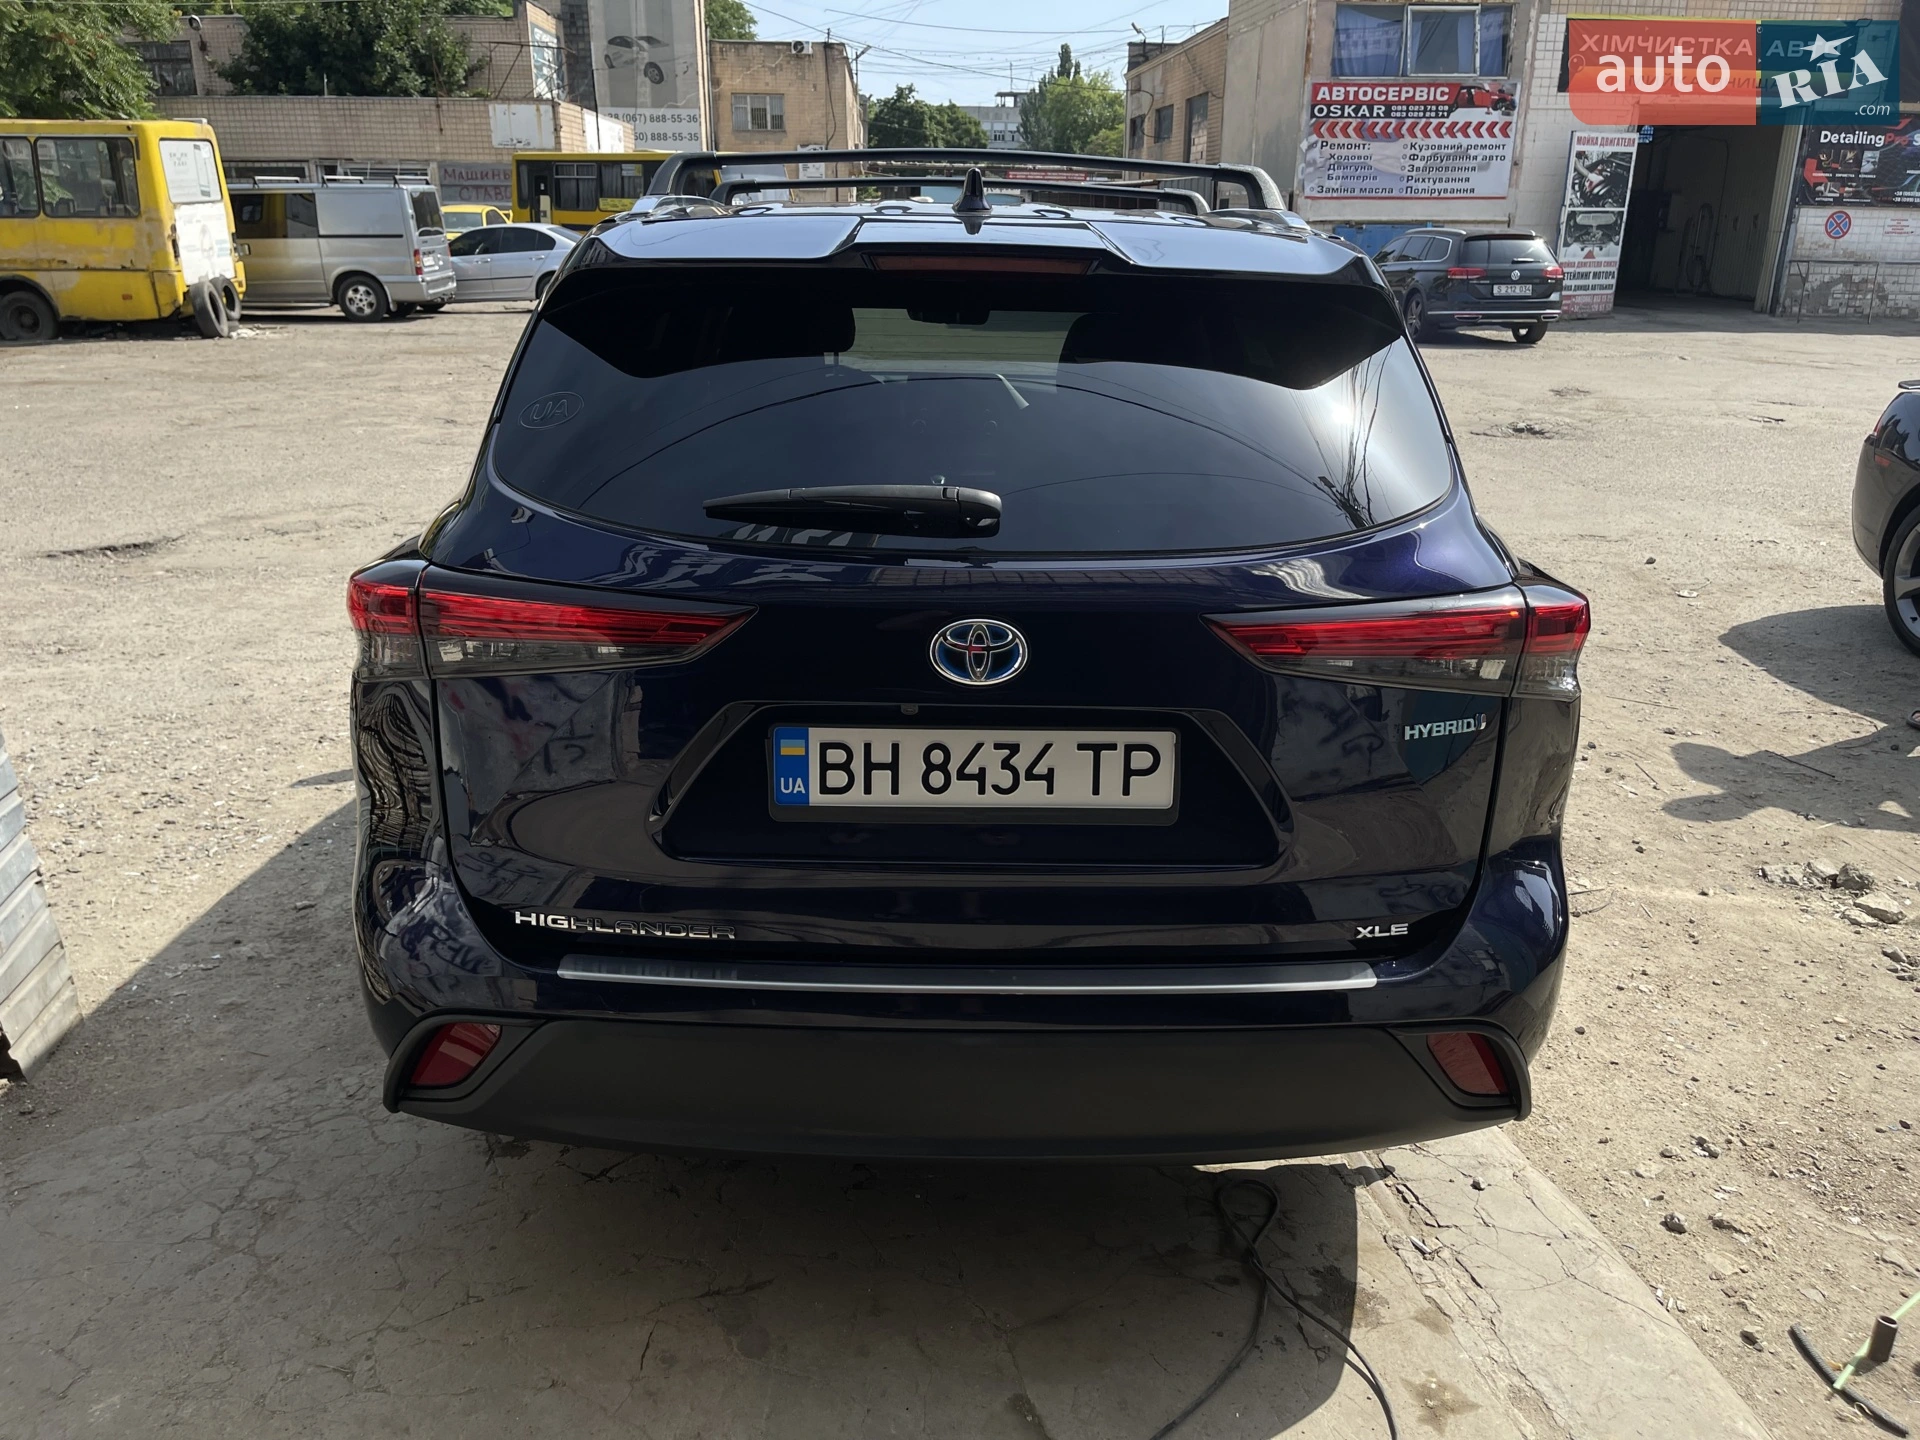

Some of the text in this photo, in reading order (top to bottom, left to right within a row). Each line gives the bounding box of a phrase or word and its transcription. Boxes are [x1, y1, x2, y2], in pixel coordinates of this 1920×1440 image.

[1579, 34, 1753, 56] ХІМЧИСТКА
[1316, 86, 1450, 101] АВТОСЕРВІС
[1313, 104, 1386, 117] OSKAR
[622, 113, 647, 124] (067)
[649, 114, 698, 124] 888-55-36
[650, 132, 699, 142] 888-55-35
[1576, 135, 1636, 148] МОЙКА ДВИГАТЕЛЯ
[1320, 140, 1371, 150] Ремонт:
[1410, 142, 1506, 152] Кузовний ремонт
[1328, 153, 1373, 161] Ходової
[1408, 153, 1506, 164] Фарбування авто
[1327, 163, 1373, 172] Двигуна
[1407, 164, 1477, 174] Зварювання
[1327, 173, 1378, 182] Бамперів
[1406, 175, 1471, 185] Рихтування
[1317, 185, 1394, 194] Заміна масла
[1405, 185, 1476, 196] Полірування
[1564, 270, 1616, 281] ЕТЕЙЛИНГ МОТОРА
[1404, 718, 1477, 740] HYBRID
[818, 741, 1162, 796] BH 8434 TP
[780, 777, 806, 794] UA
[514, 911, 736, 940] HIGHLANDER
[1356, 923, 1408, 939] XLE
